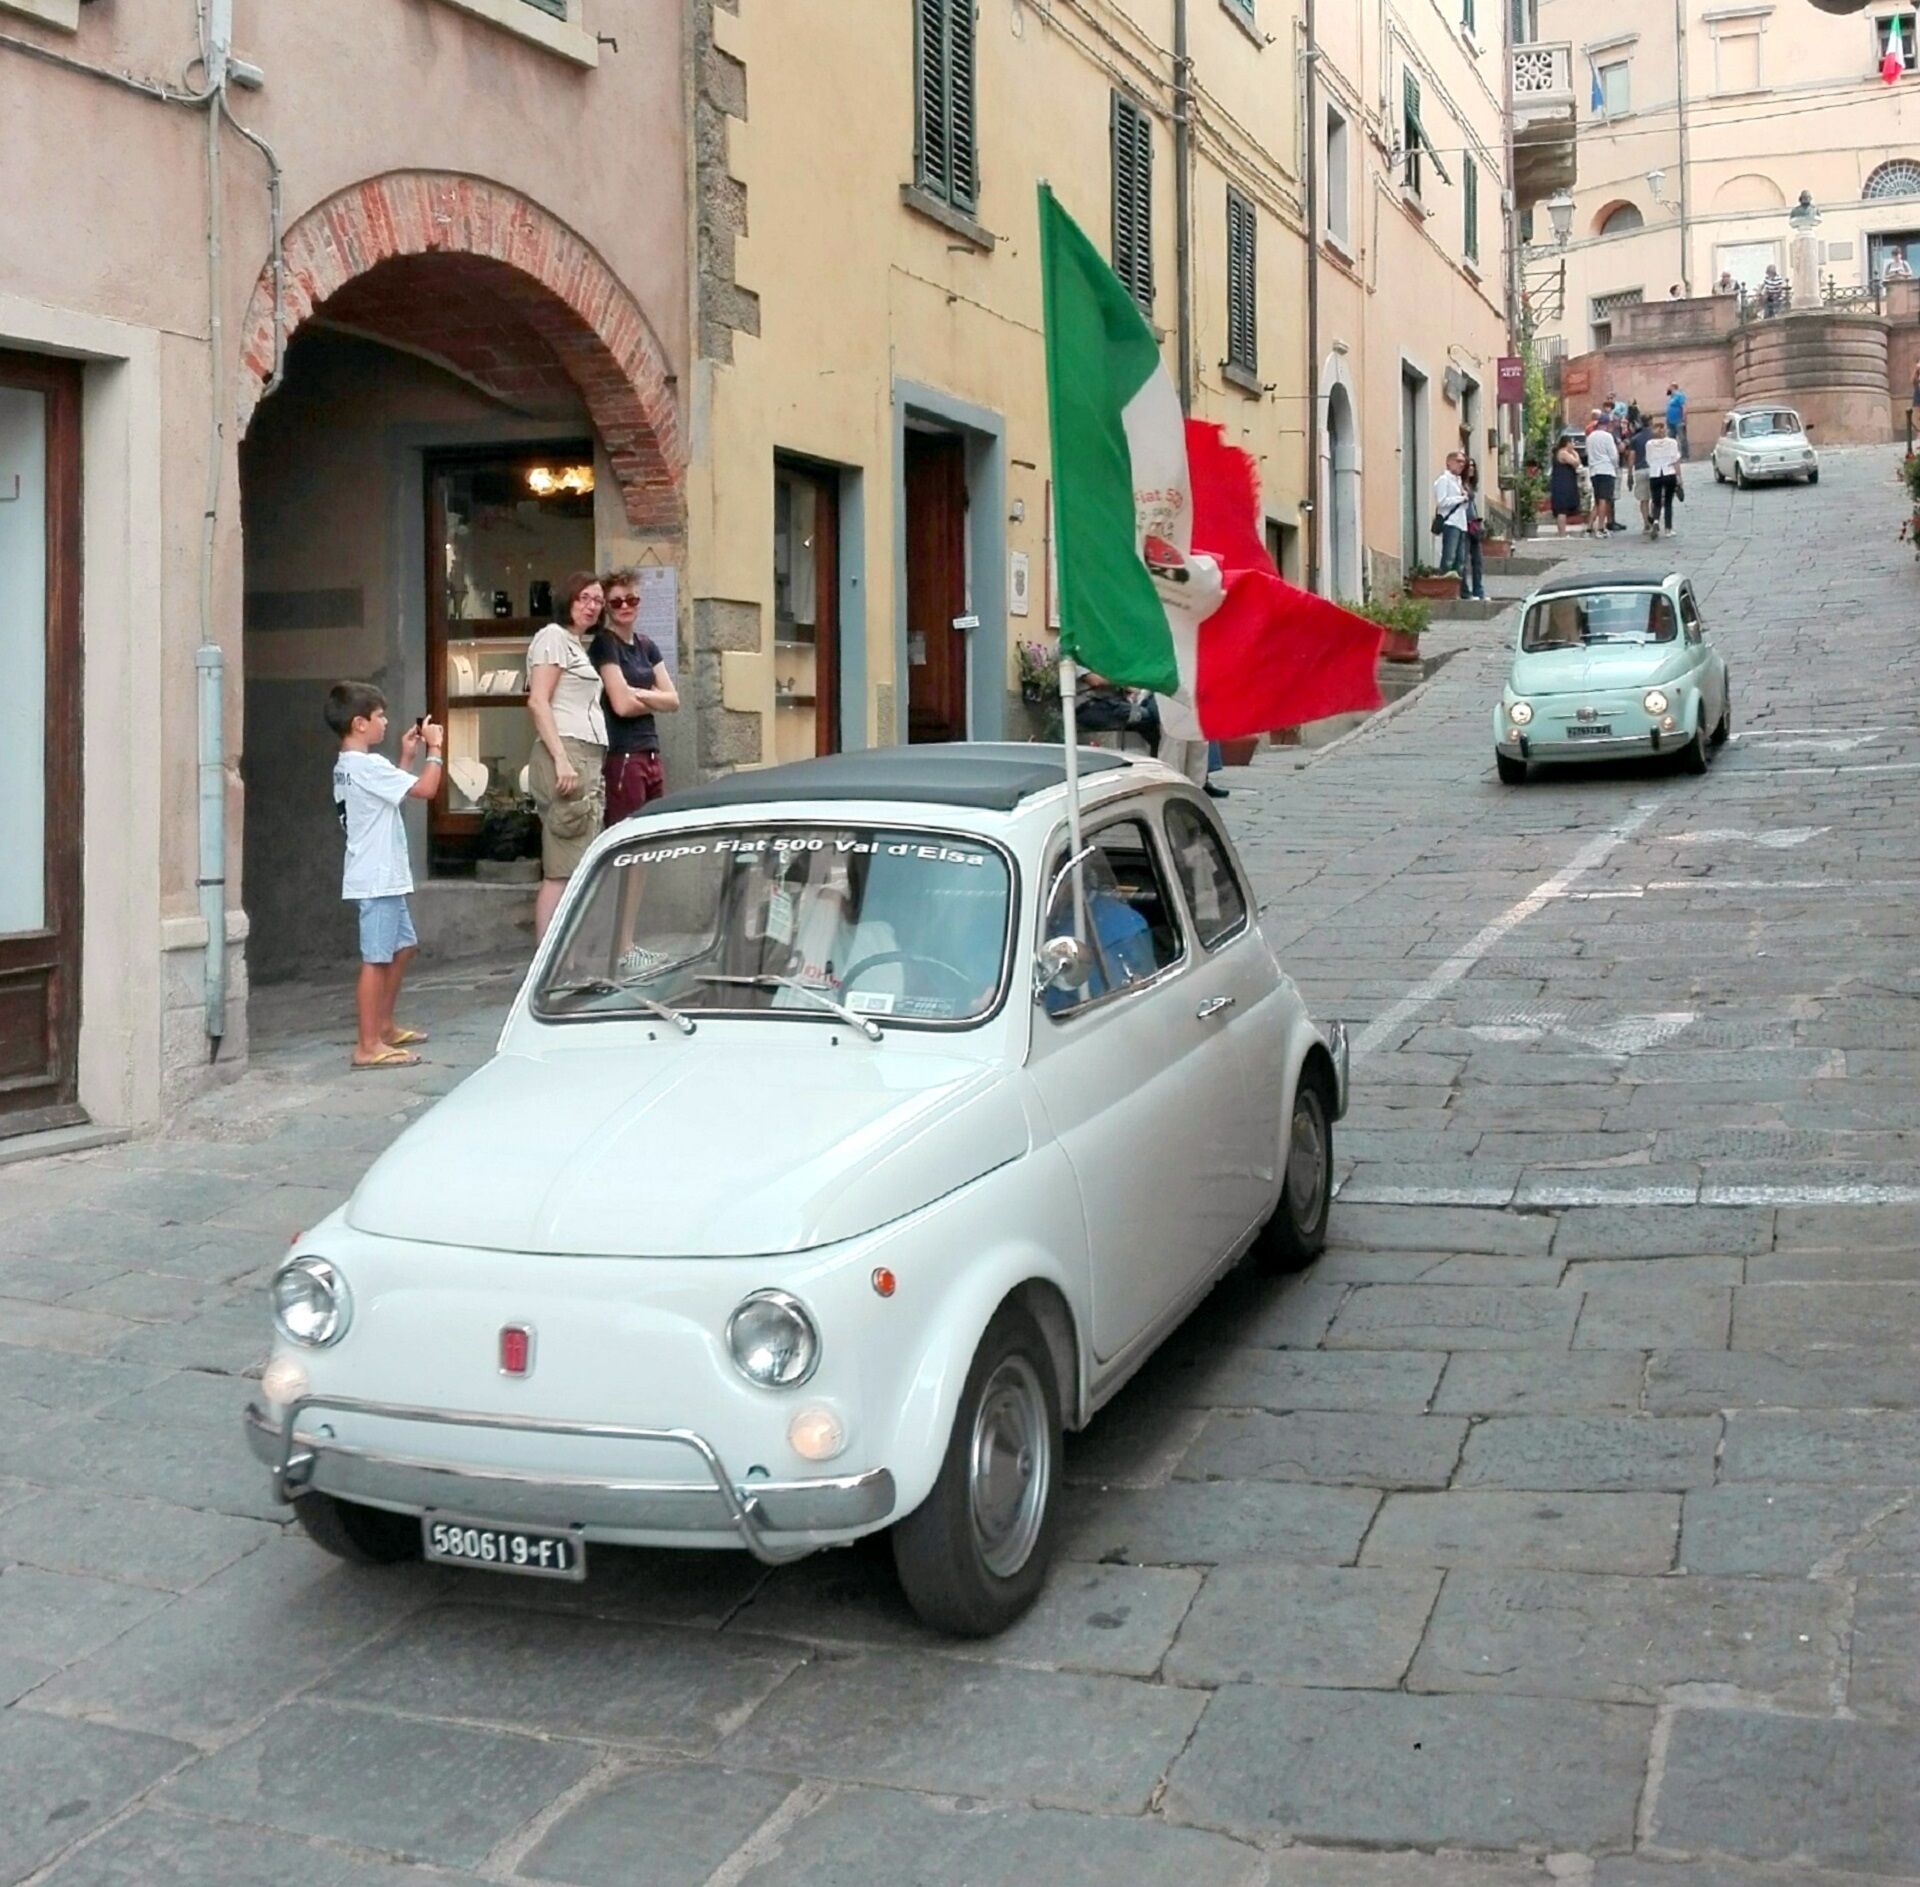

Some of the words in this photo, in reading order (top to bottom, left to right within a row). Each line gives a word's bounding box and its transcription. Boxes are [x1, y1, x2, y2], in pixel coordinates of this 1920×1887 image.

[612, 844, 707, 868] Gruppo
[713, 839, 767, 853] Fiat
[772, 838, 824, 851] 500
[834, 839, 880, 854] Val
[887, 844, 984, 866] d'Elsa
